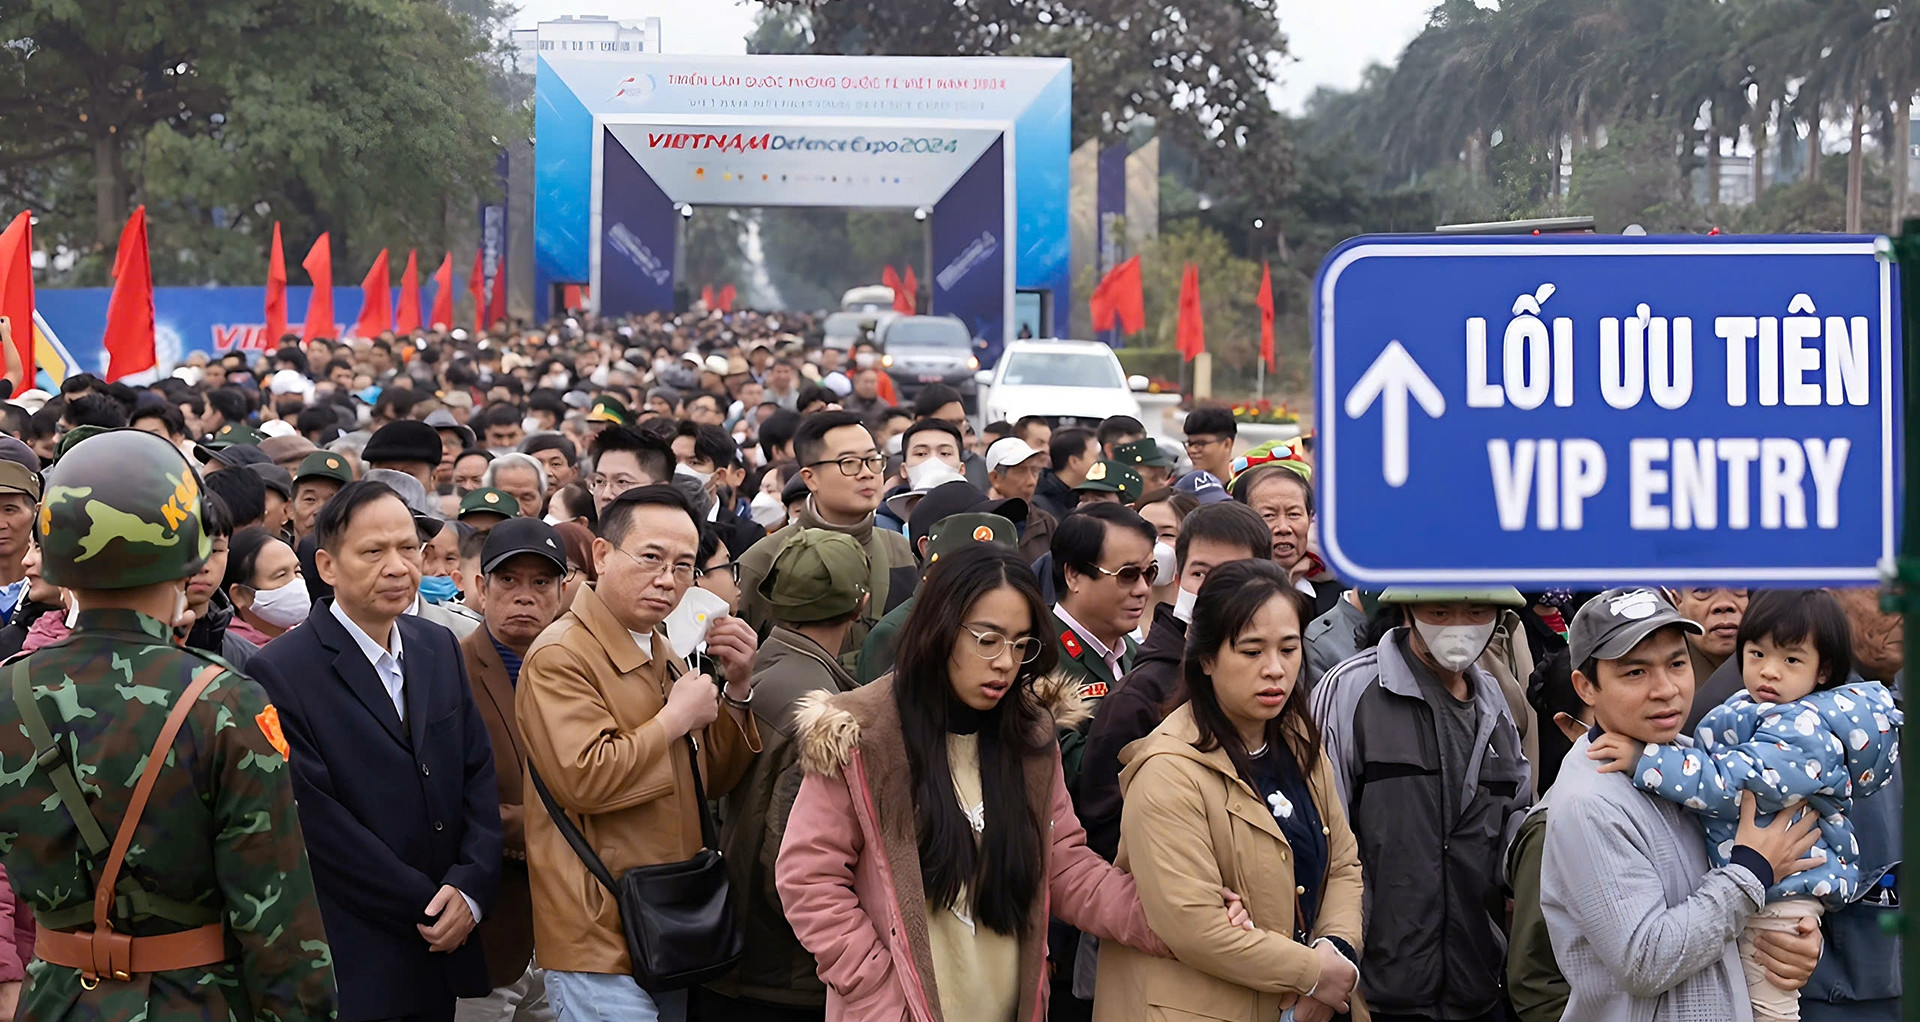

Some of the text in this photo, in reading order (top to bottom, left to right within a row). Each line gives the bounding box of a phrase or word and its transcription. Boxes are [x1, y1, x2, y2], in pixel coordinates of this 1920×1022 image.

[850, 136, 899, 154] Expo
[899, 137, 958, 153] 2024
[1466, 283, 1870, 410] LỐI ƯU TIÊN
[1486, 438, 1852, 530] VIP ENTRY
